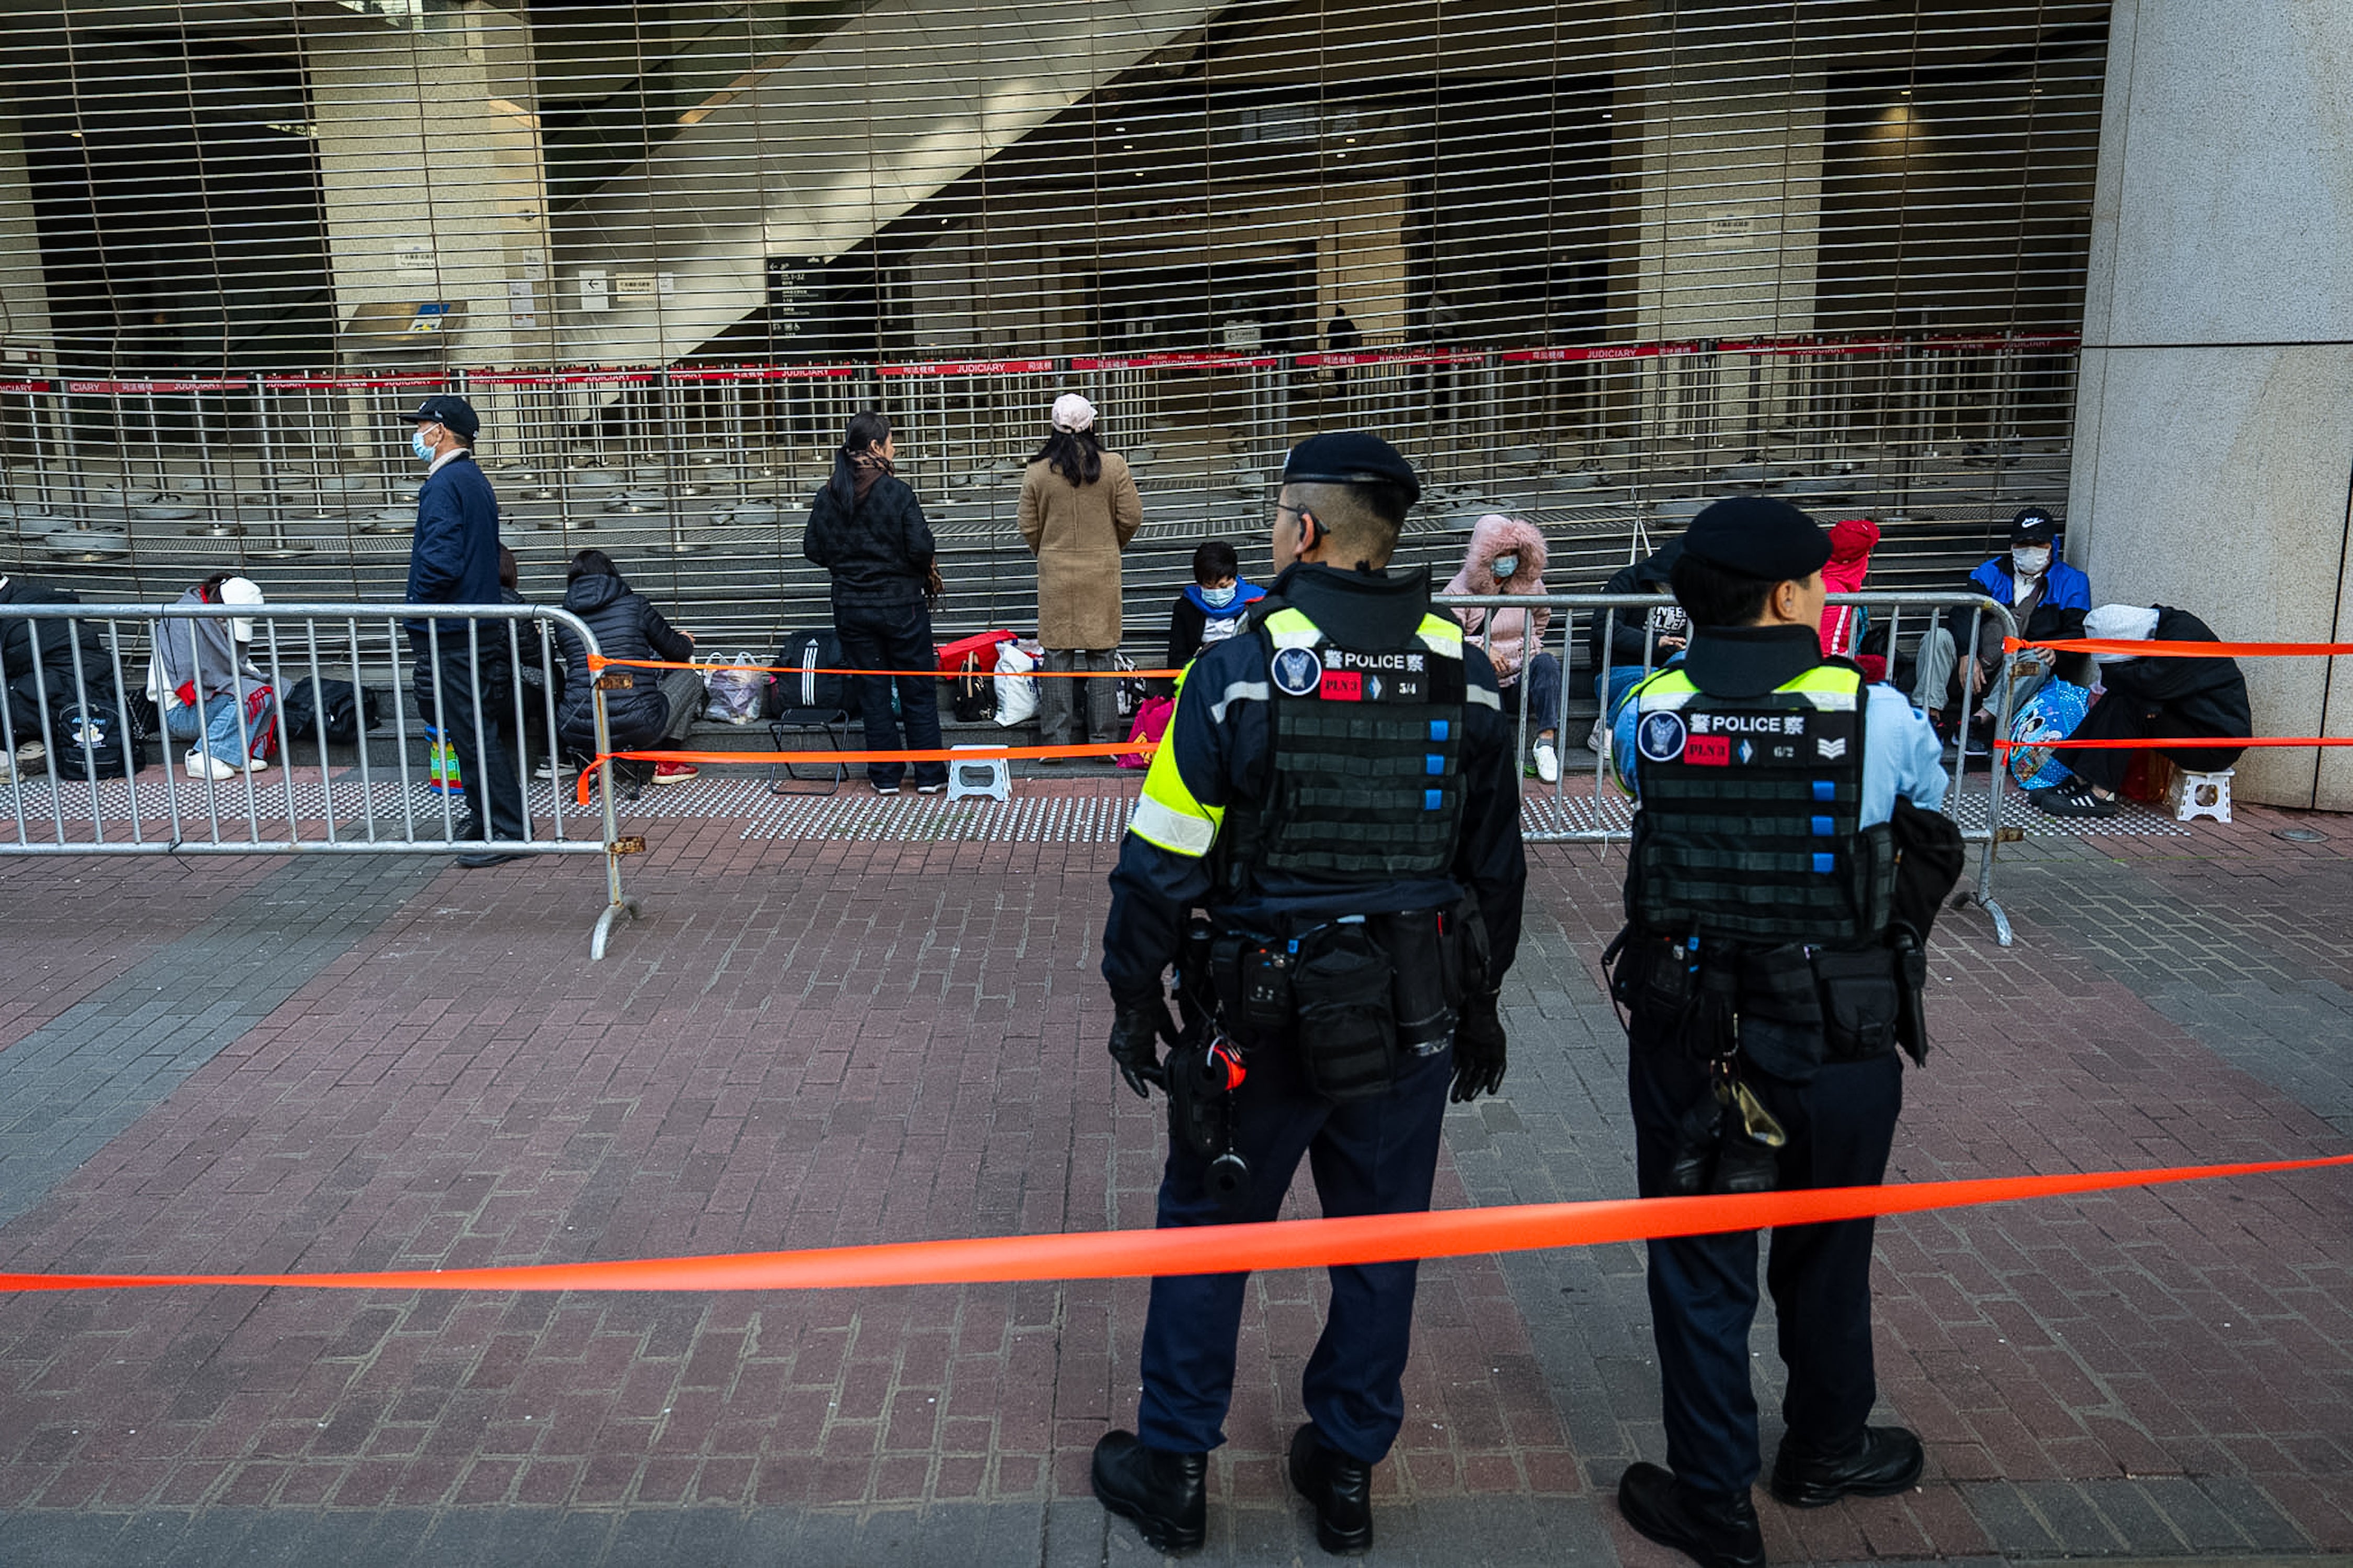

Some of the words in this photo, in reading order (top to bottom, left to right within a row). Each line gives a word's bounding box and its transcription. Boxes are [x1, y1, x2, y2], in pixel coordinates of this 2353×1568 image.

[1586, 348, 1637, 359] JUDICIARY
[956, 364, 1005, 373] JUDICIARY
[1642, 615, 1686, 631] LEEP
[1344, 653, 1405, 670] POLICE
[1406, 654, 1424, 672] 察
[1712, 716, 1781, 732] POLICE
[1783, 716, 1804, 735] 察
